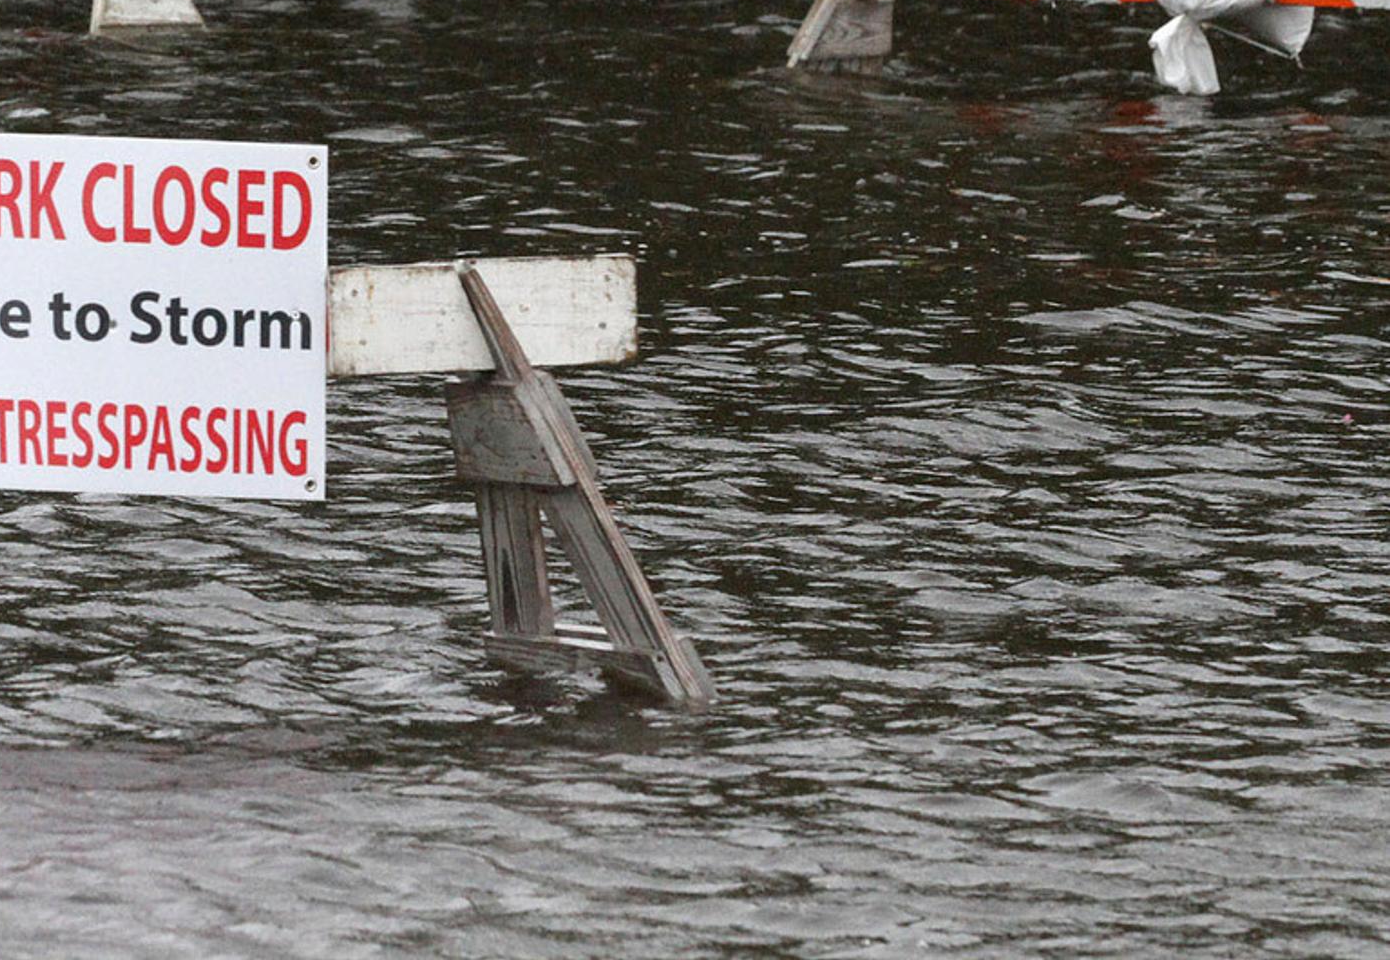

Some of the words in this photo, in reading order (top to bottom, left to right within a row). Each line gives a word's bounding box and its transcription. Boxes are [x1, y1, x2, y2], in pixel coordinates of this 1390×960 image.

[81, 162, 313, 251] CLOSED
[48, 292, 110, 342] to
[130, 291, 312, 350] Storm
